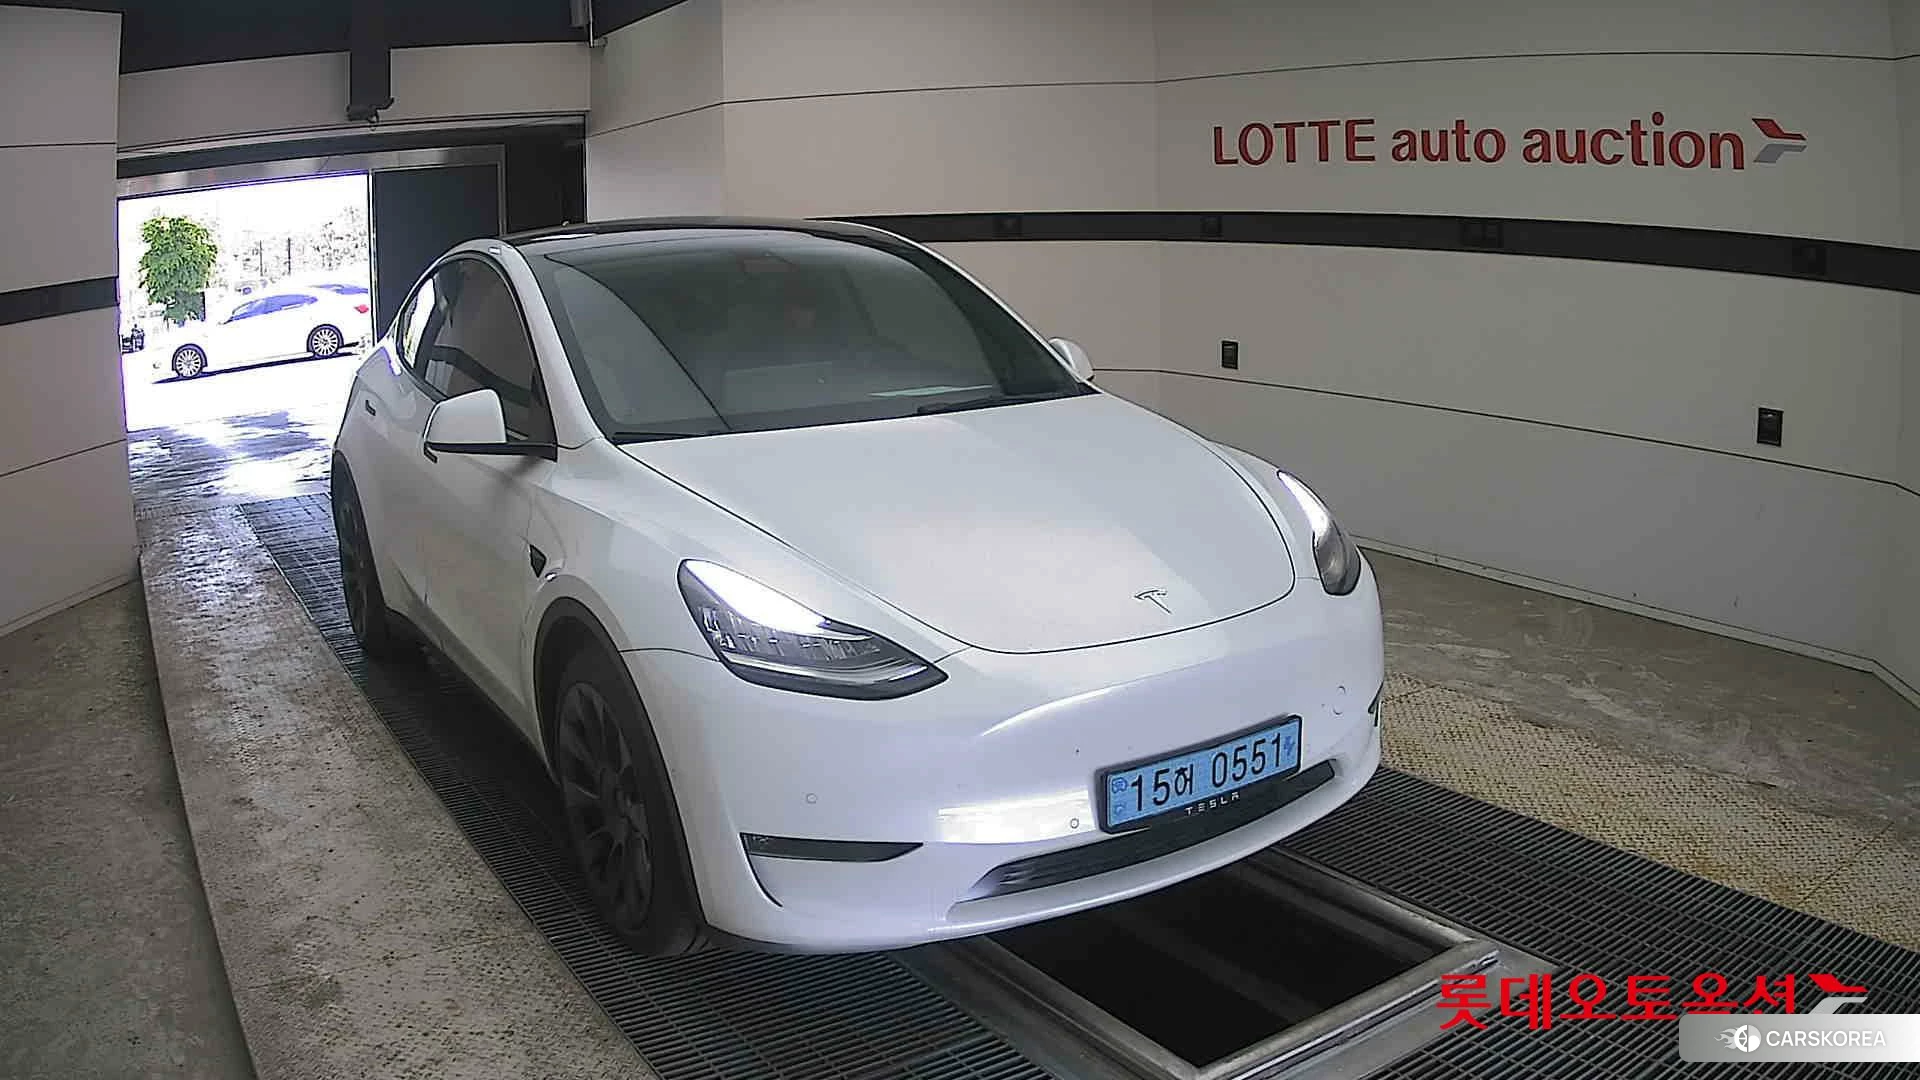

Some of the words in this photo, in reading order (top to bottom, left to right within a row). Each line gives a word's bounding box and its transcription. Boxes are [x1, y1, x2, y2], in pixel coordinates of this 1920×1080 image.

[1213, 118, 1377, 165] LOTTE
[1391, 119, 1506, 162] auto
[1522, 111, 1745, 170] auction
[1131, 763, 1195, 812] 15허
[1211, 732, 1282, 788] 0551
[1185, 791, 1241, 817] TESLA
